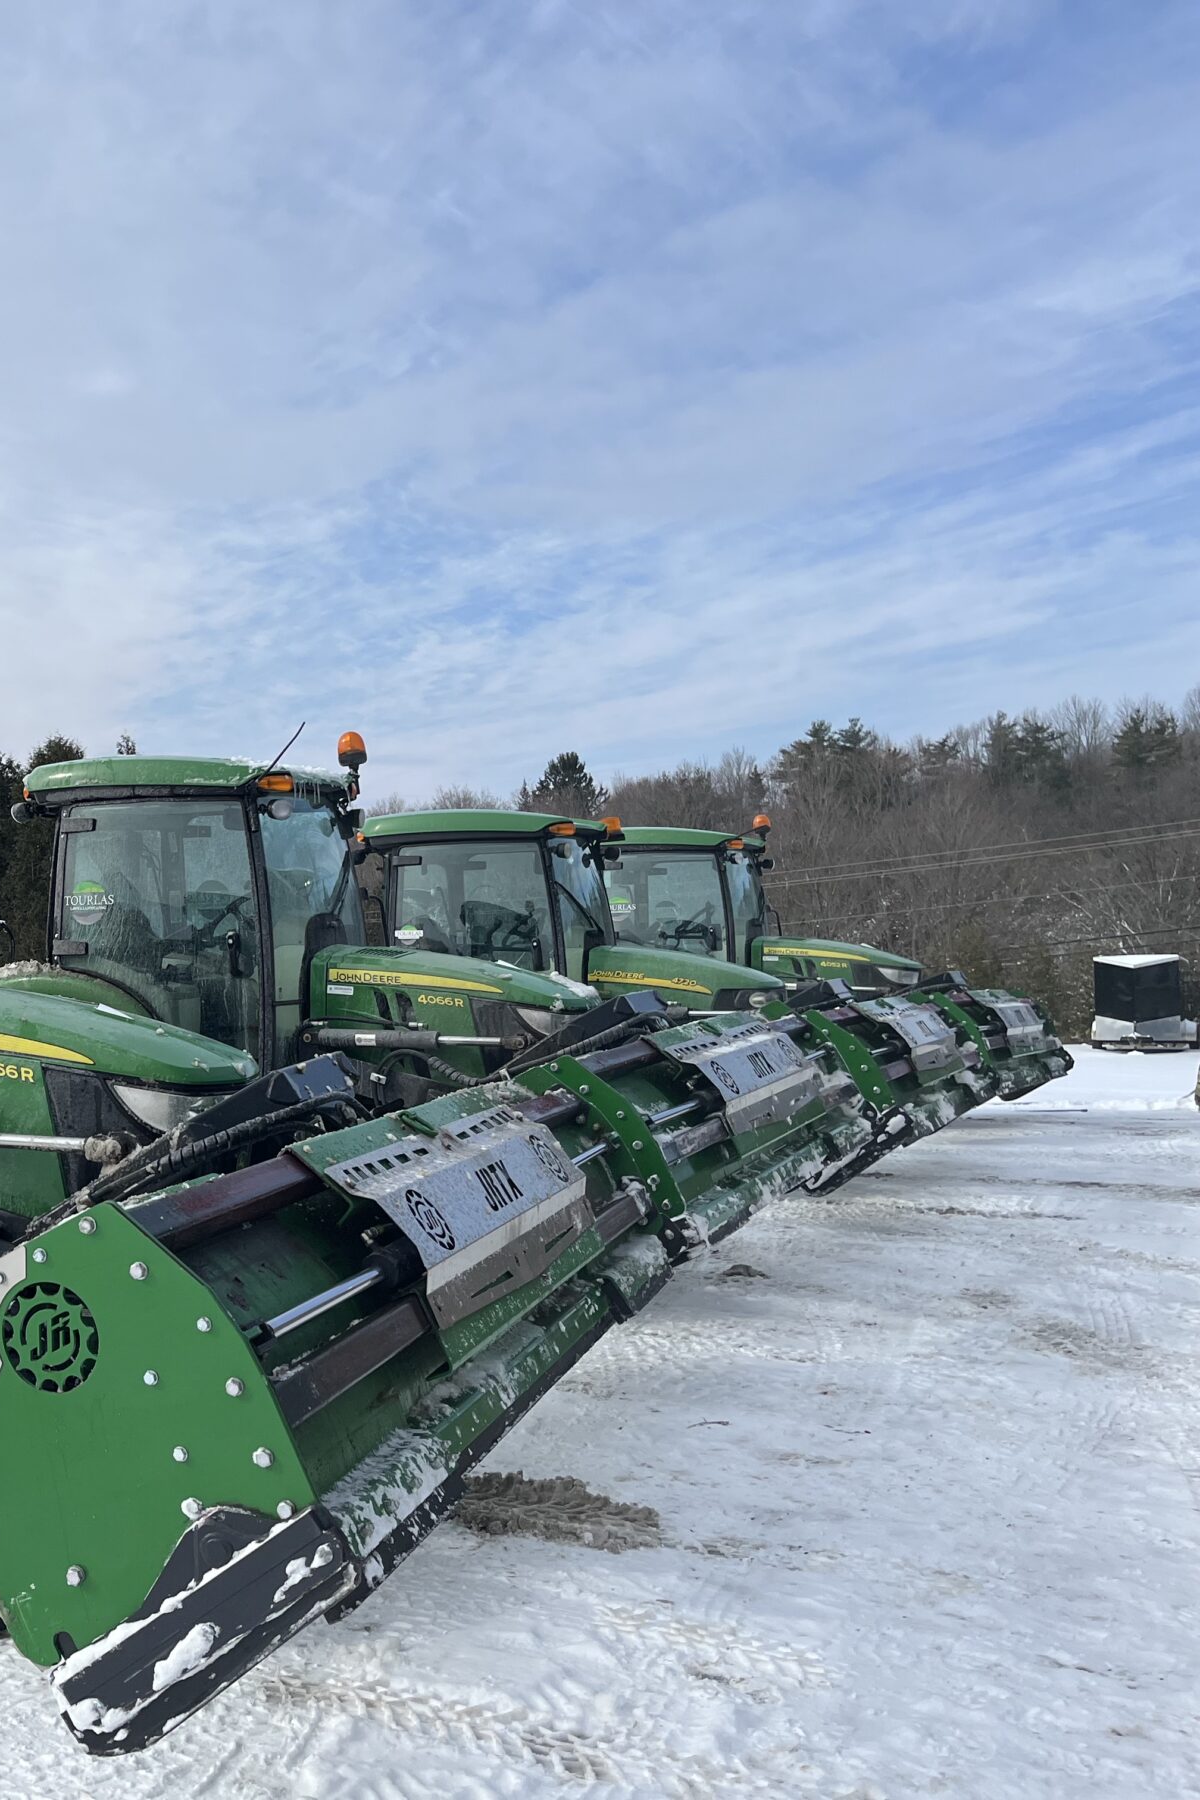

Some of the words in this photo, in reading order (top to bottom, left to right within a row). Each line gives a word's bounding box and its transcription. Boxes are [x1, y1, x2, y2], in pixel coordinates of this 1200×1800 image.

[64, 894, 115, 906] TOURLAS
[333, 971, 362, 982] JOHN
[363, 972, 402, 984] DEERE
[589, 969, 614, 977] JOHN
[614, 970, 645, 980] DEERE
[671, 977, 697, 986] 4720
[474, 1159, 524, 1212] JRTX
